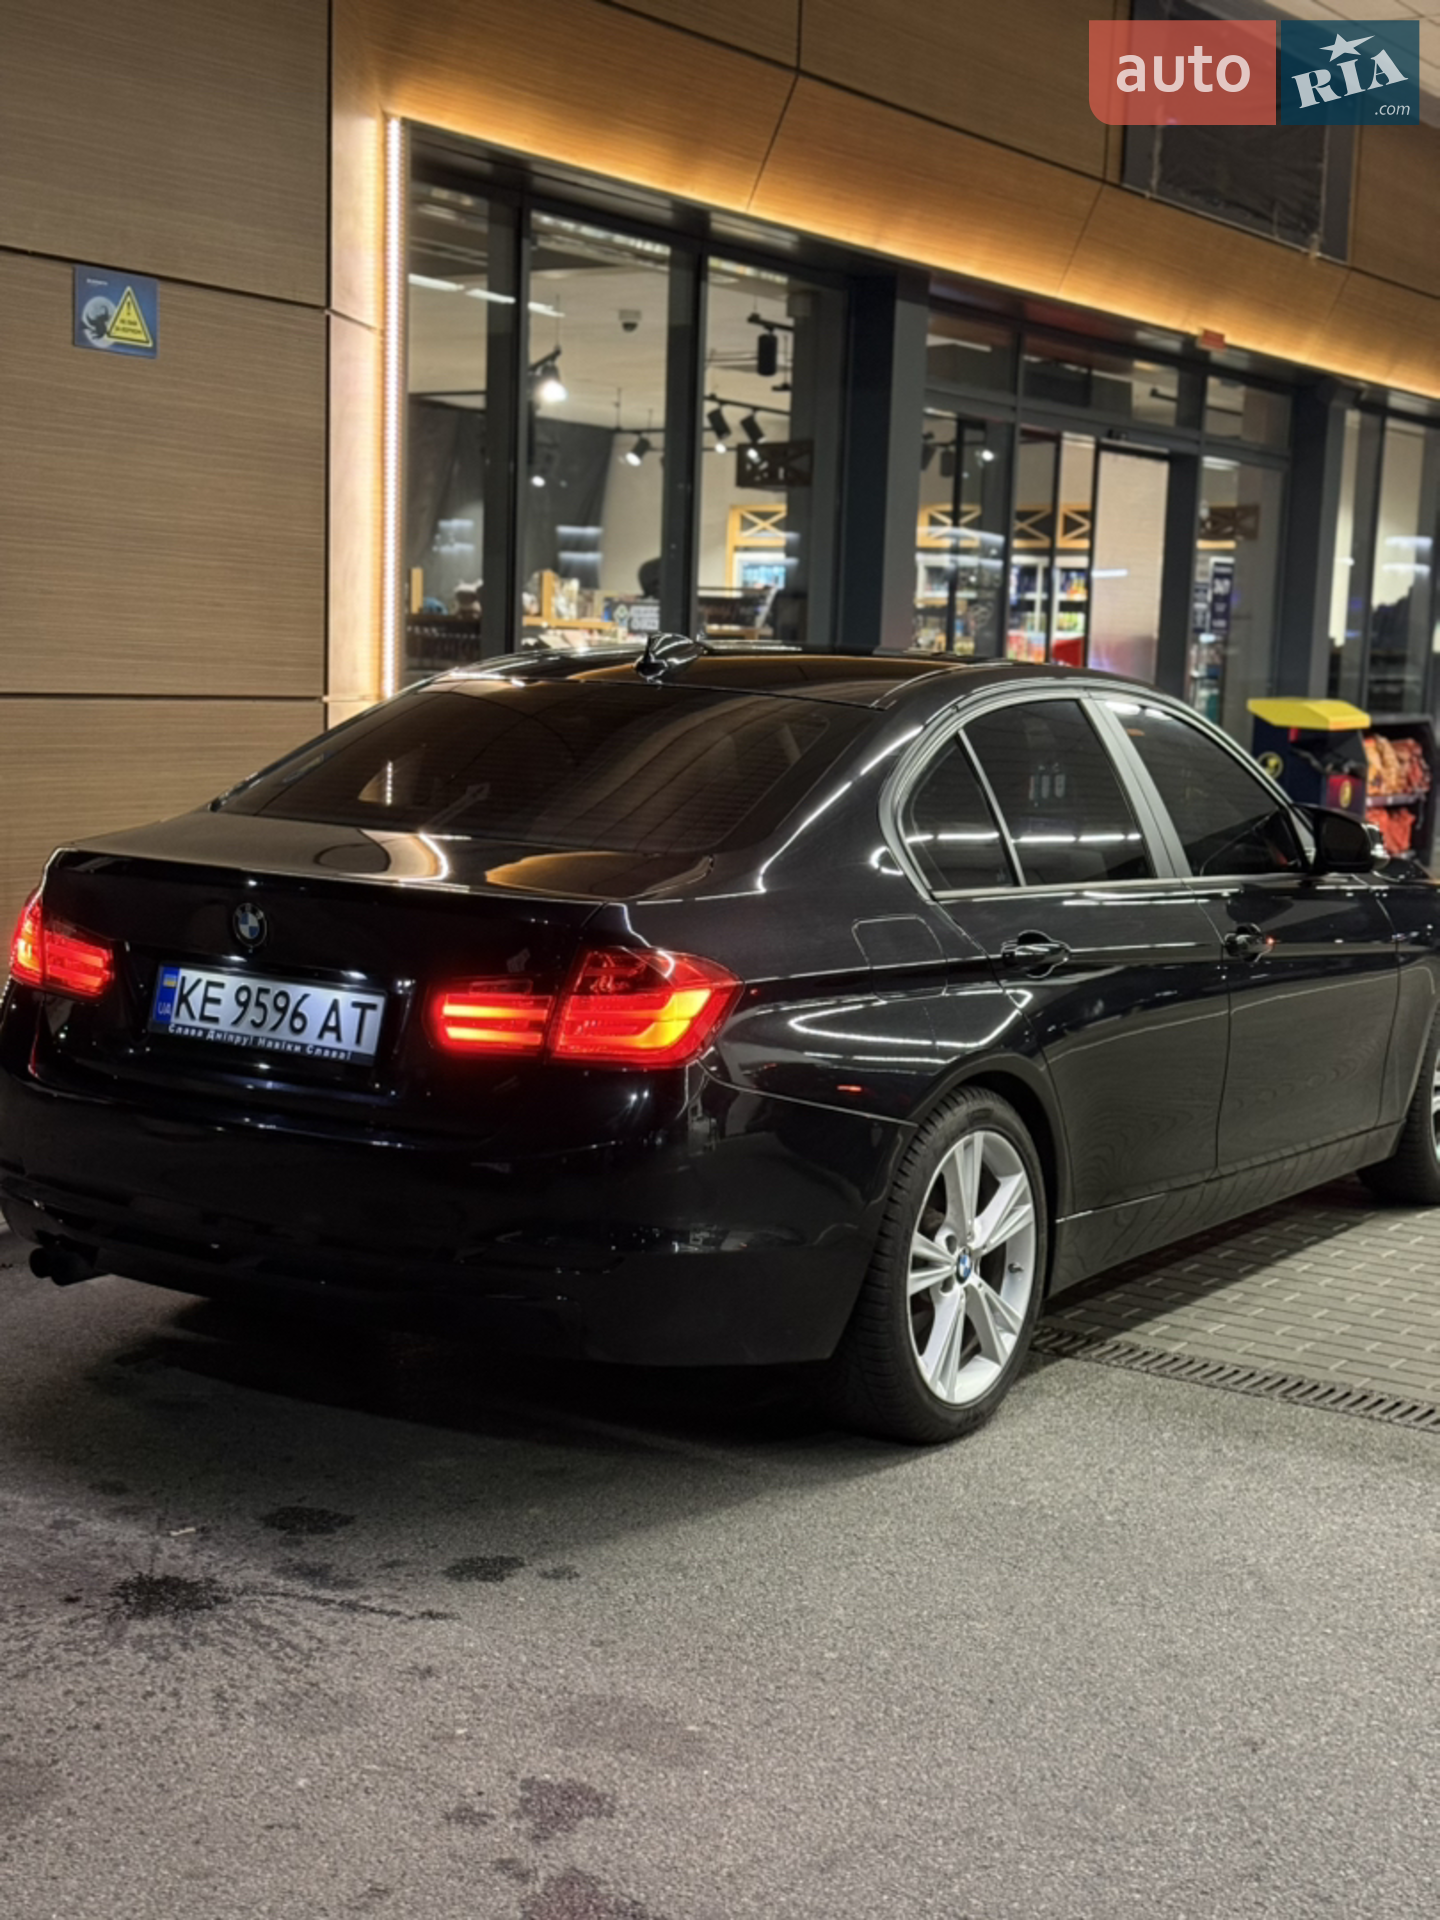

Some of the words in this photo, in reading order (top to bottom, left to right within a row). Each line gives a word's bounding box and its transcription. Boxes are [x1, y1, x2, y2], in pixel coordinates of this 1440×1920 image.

[157, 1002, 171, 1015] UA
[174, 976, 226, 1024] KE
[231, 984, 311, 1035] 9596
[317, 998, 378, 1047] AT
[168, 1023, 204, 1037] Слава
